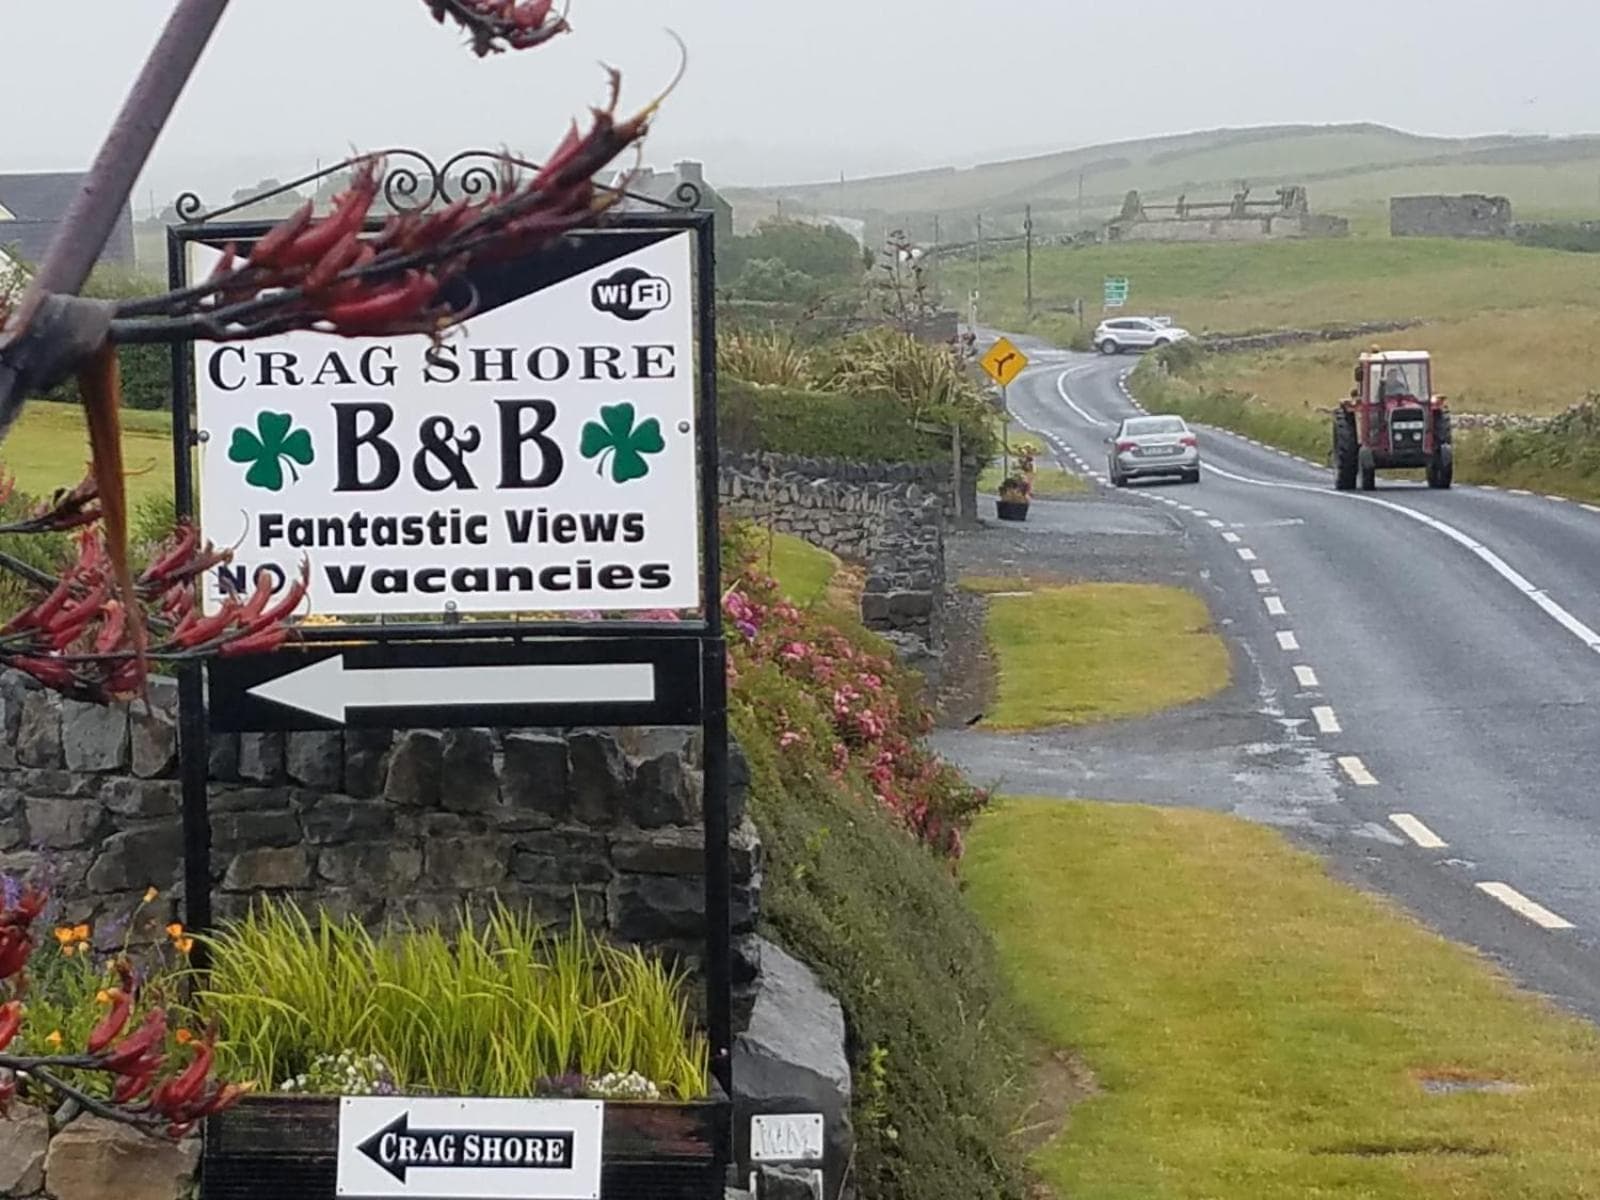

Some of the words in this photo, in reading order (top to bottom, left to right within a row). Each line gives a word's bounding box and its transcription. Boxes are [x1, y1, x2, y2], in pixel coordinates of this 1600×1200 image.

[208, 345, 398, 391] CRAG
[423, 344, 676, 385] SHORE
[331, 398, 564, 492] B&B
[258, 509, 488, 547] Fantastic
[506, 507, 645, 543] Views
[218, 563, 286, 595] NO
[325, 560, 671, 594] Vacancies
[380, 1133, 455, 1162] CRAG
[463, 1133, 564, 1162] SHORE
